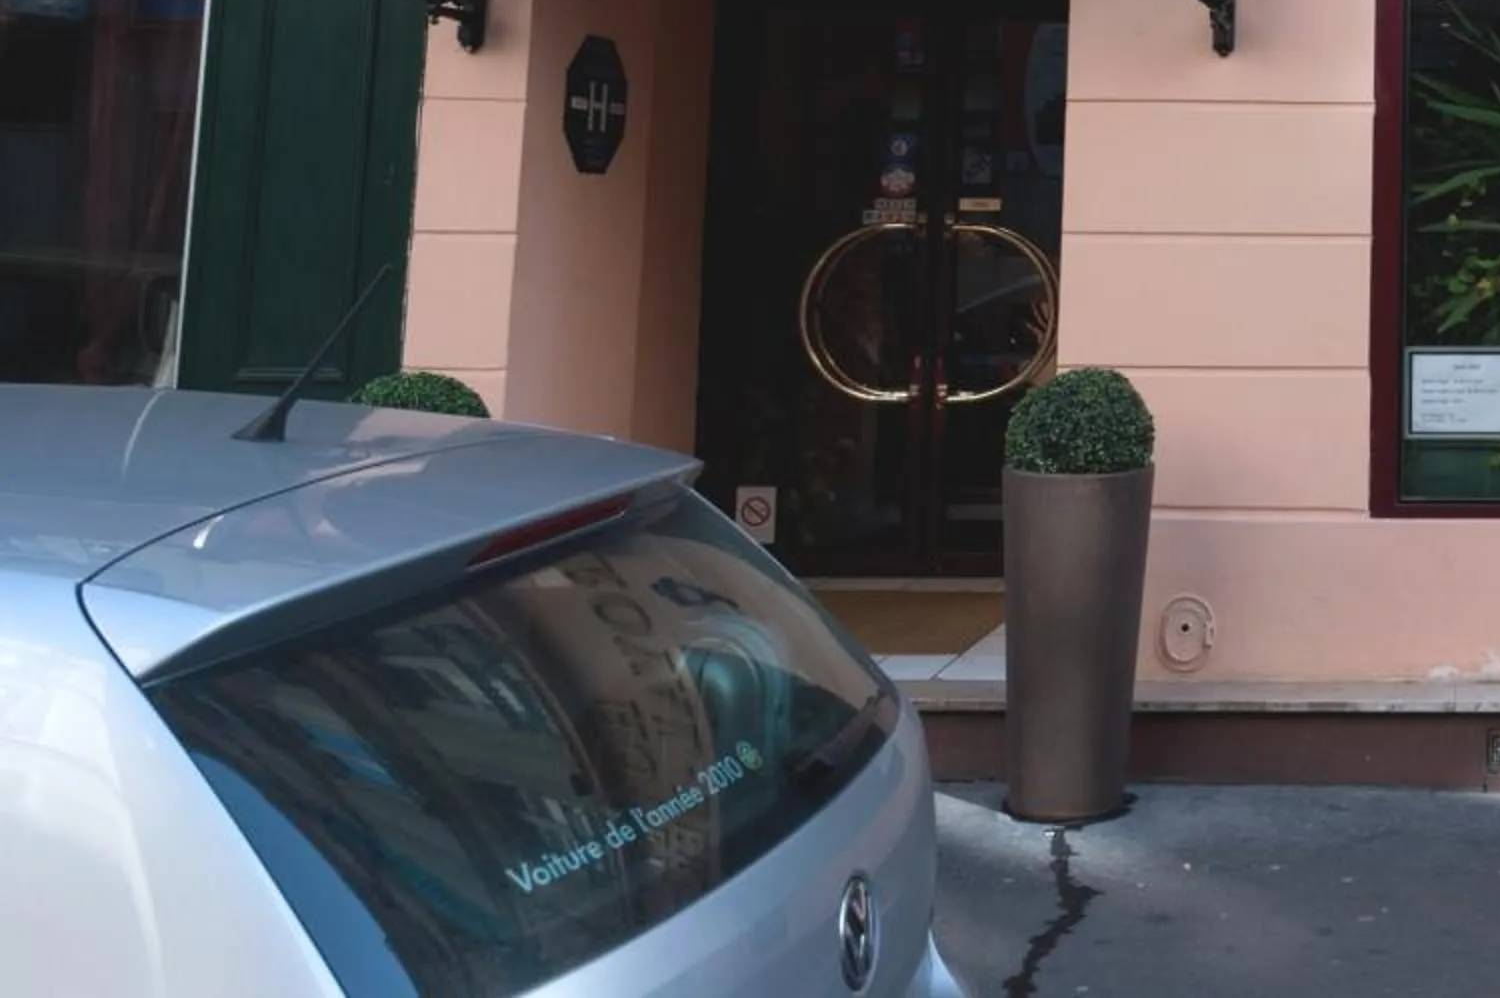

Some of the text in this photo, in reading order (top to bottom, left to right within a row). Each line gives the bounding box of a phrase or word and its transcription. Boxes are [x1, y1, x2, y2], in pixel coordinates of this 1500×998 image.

[505, 754, 745, 895] Voiture de l'année 2010
